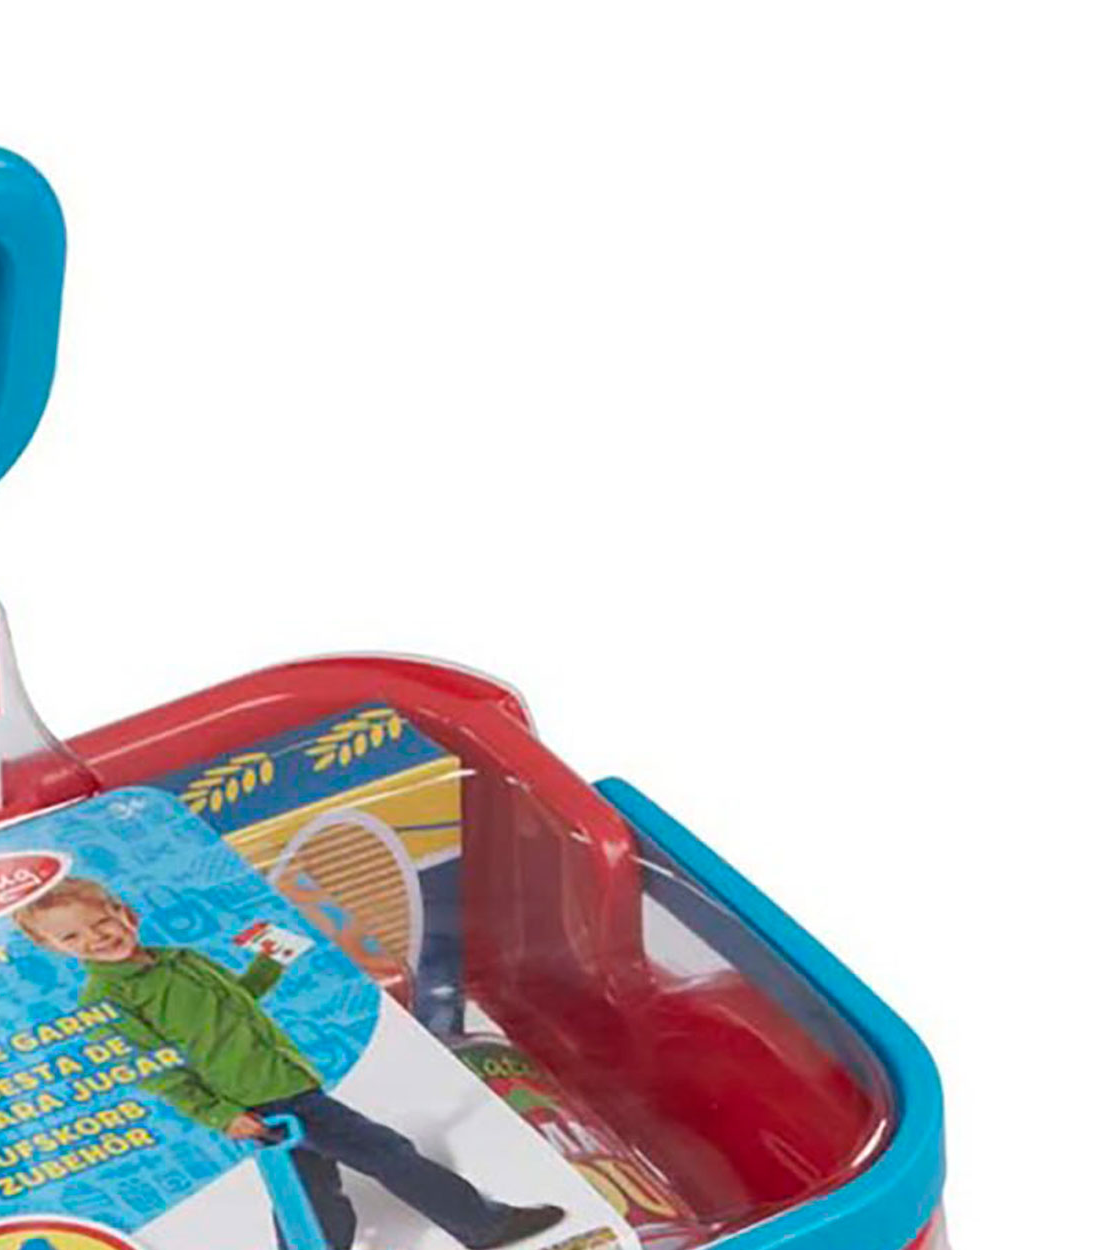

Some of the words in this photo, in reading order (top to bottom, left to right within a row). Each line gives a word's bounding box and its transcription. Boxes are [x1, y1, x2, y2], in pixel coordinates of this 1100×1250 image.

[11, 1001, 119, 1052] GARNI
[85, 1036, 133, 1065] DE
[71, 1047, 185, 1103] JUGAR
